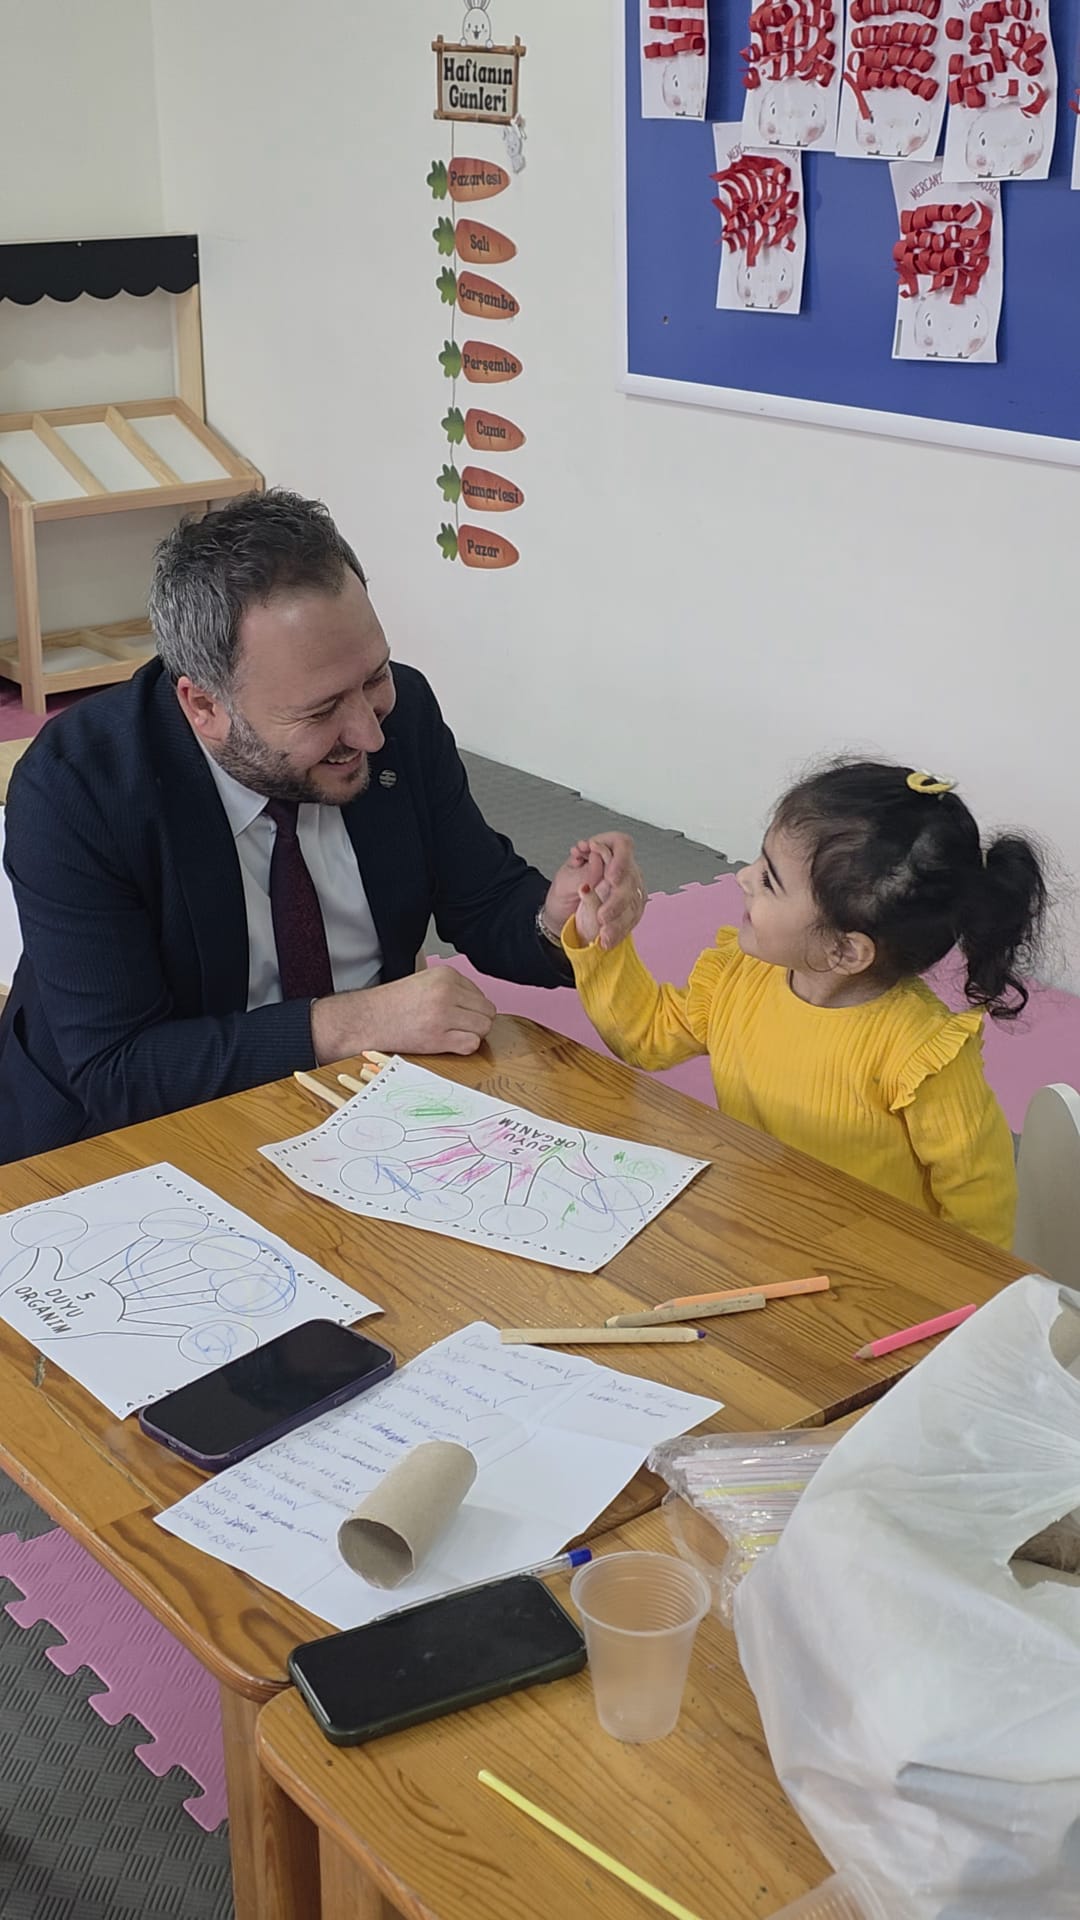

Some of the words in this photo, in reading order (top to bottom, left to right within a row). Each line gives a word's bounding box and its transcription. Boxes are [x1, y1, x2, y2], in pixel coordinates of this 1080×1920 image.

[444, 58, 512, 85] Haftanın
[449, 84, 507, 112] Günleri
[450, 168, 502, 187] Pazartesi
[459, 283, 516, 312] Çarşamba
[464, 354, 517, 375] Perşembe
[476, 421, 506, 439] Cuma
[462, 480, 519, 504] Cumartesi
[467, 539, 499, 558] Pazar
[498, 1117, 577, 1149] ORGANIM
[503, 1133, 551, 1153] DUYU
[509, 1147, 525, 1155] 5
[44, 1288, 84, 1318] DUYU
[76, 1292, 96, 1301] 5
[14, 1286, 72, 1334] ORGANIM
